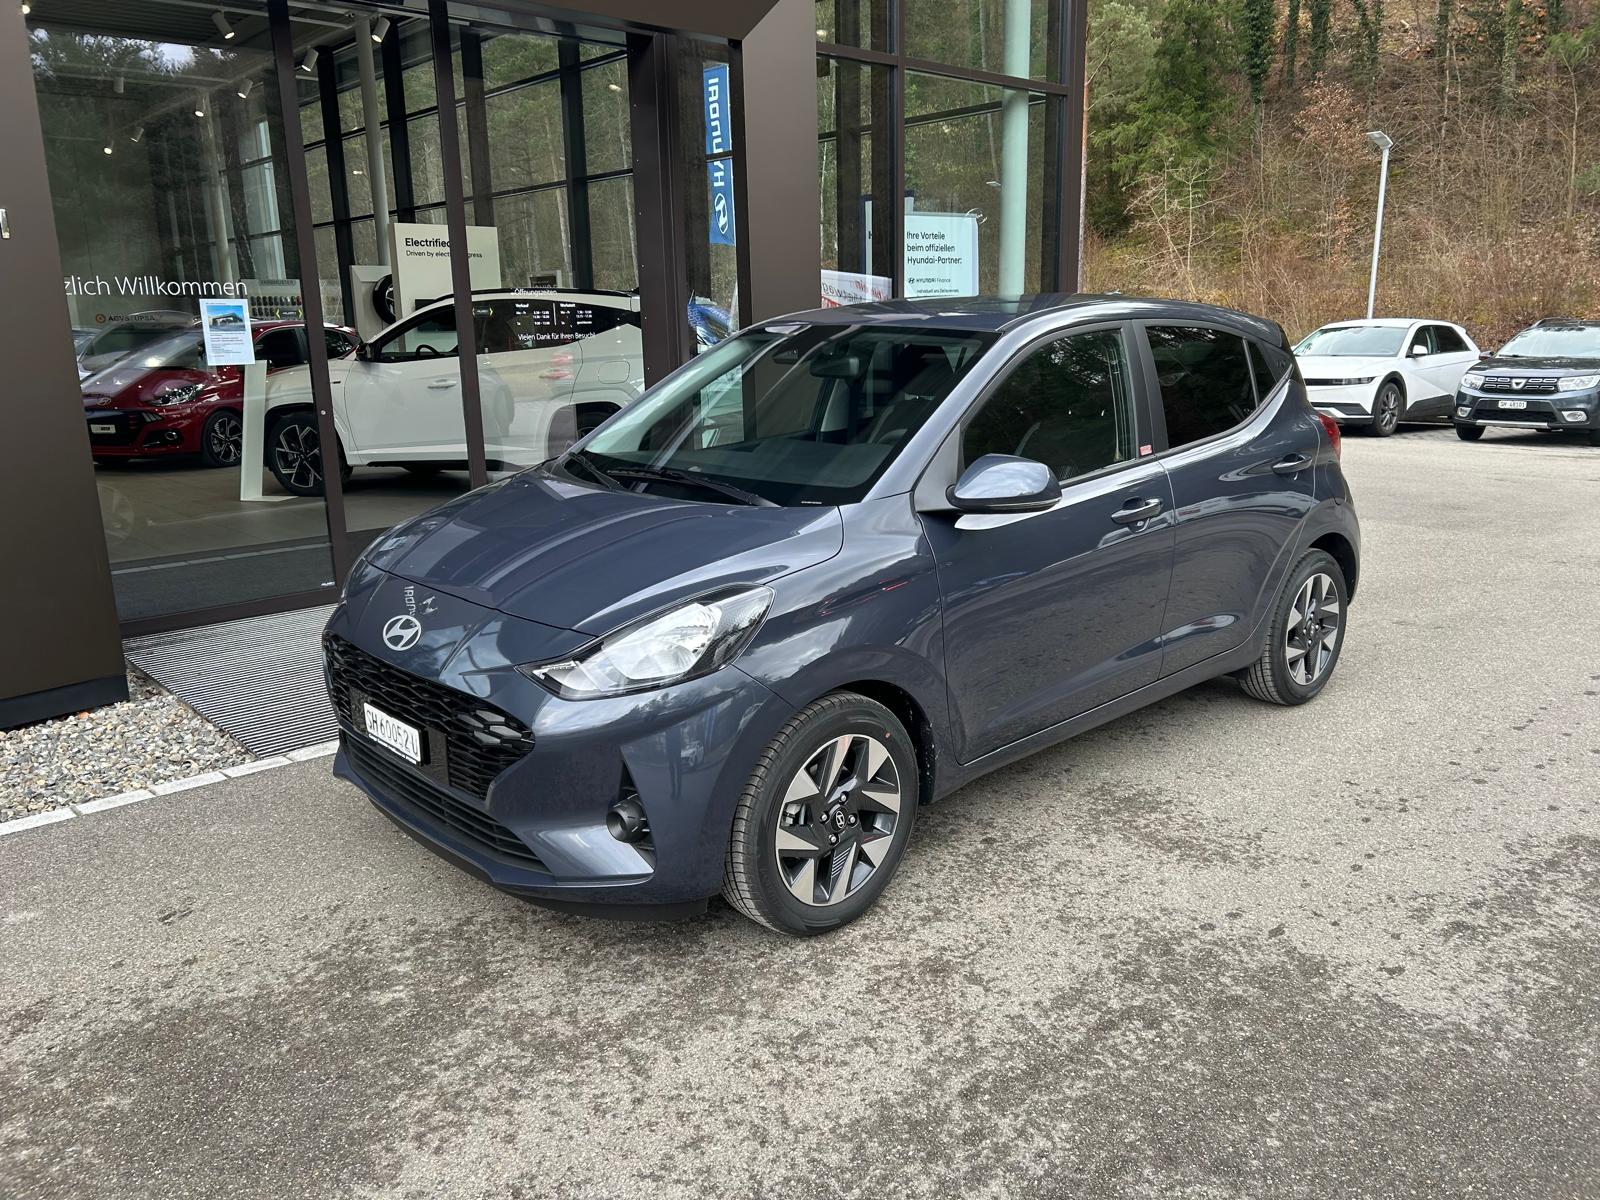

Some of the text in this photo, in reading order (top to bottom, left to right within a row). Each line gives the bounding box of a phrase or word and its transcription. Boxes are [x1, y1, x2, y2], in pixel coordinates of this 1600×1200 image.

[906, 231, 946, 240] Ihre Vorteile
[906, 243, 956, 252] beim offiziellen
[406, 250, 426, 258] Driven
[427, 250, 434, 258] by
[114, 275, 248, 296] Willkommen
[518, 333, 535, 341] Vielen
